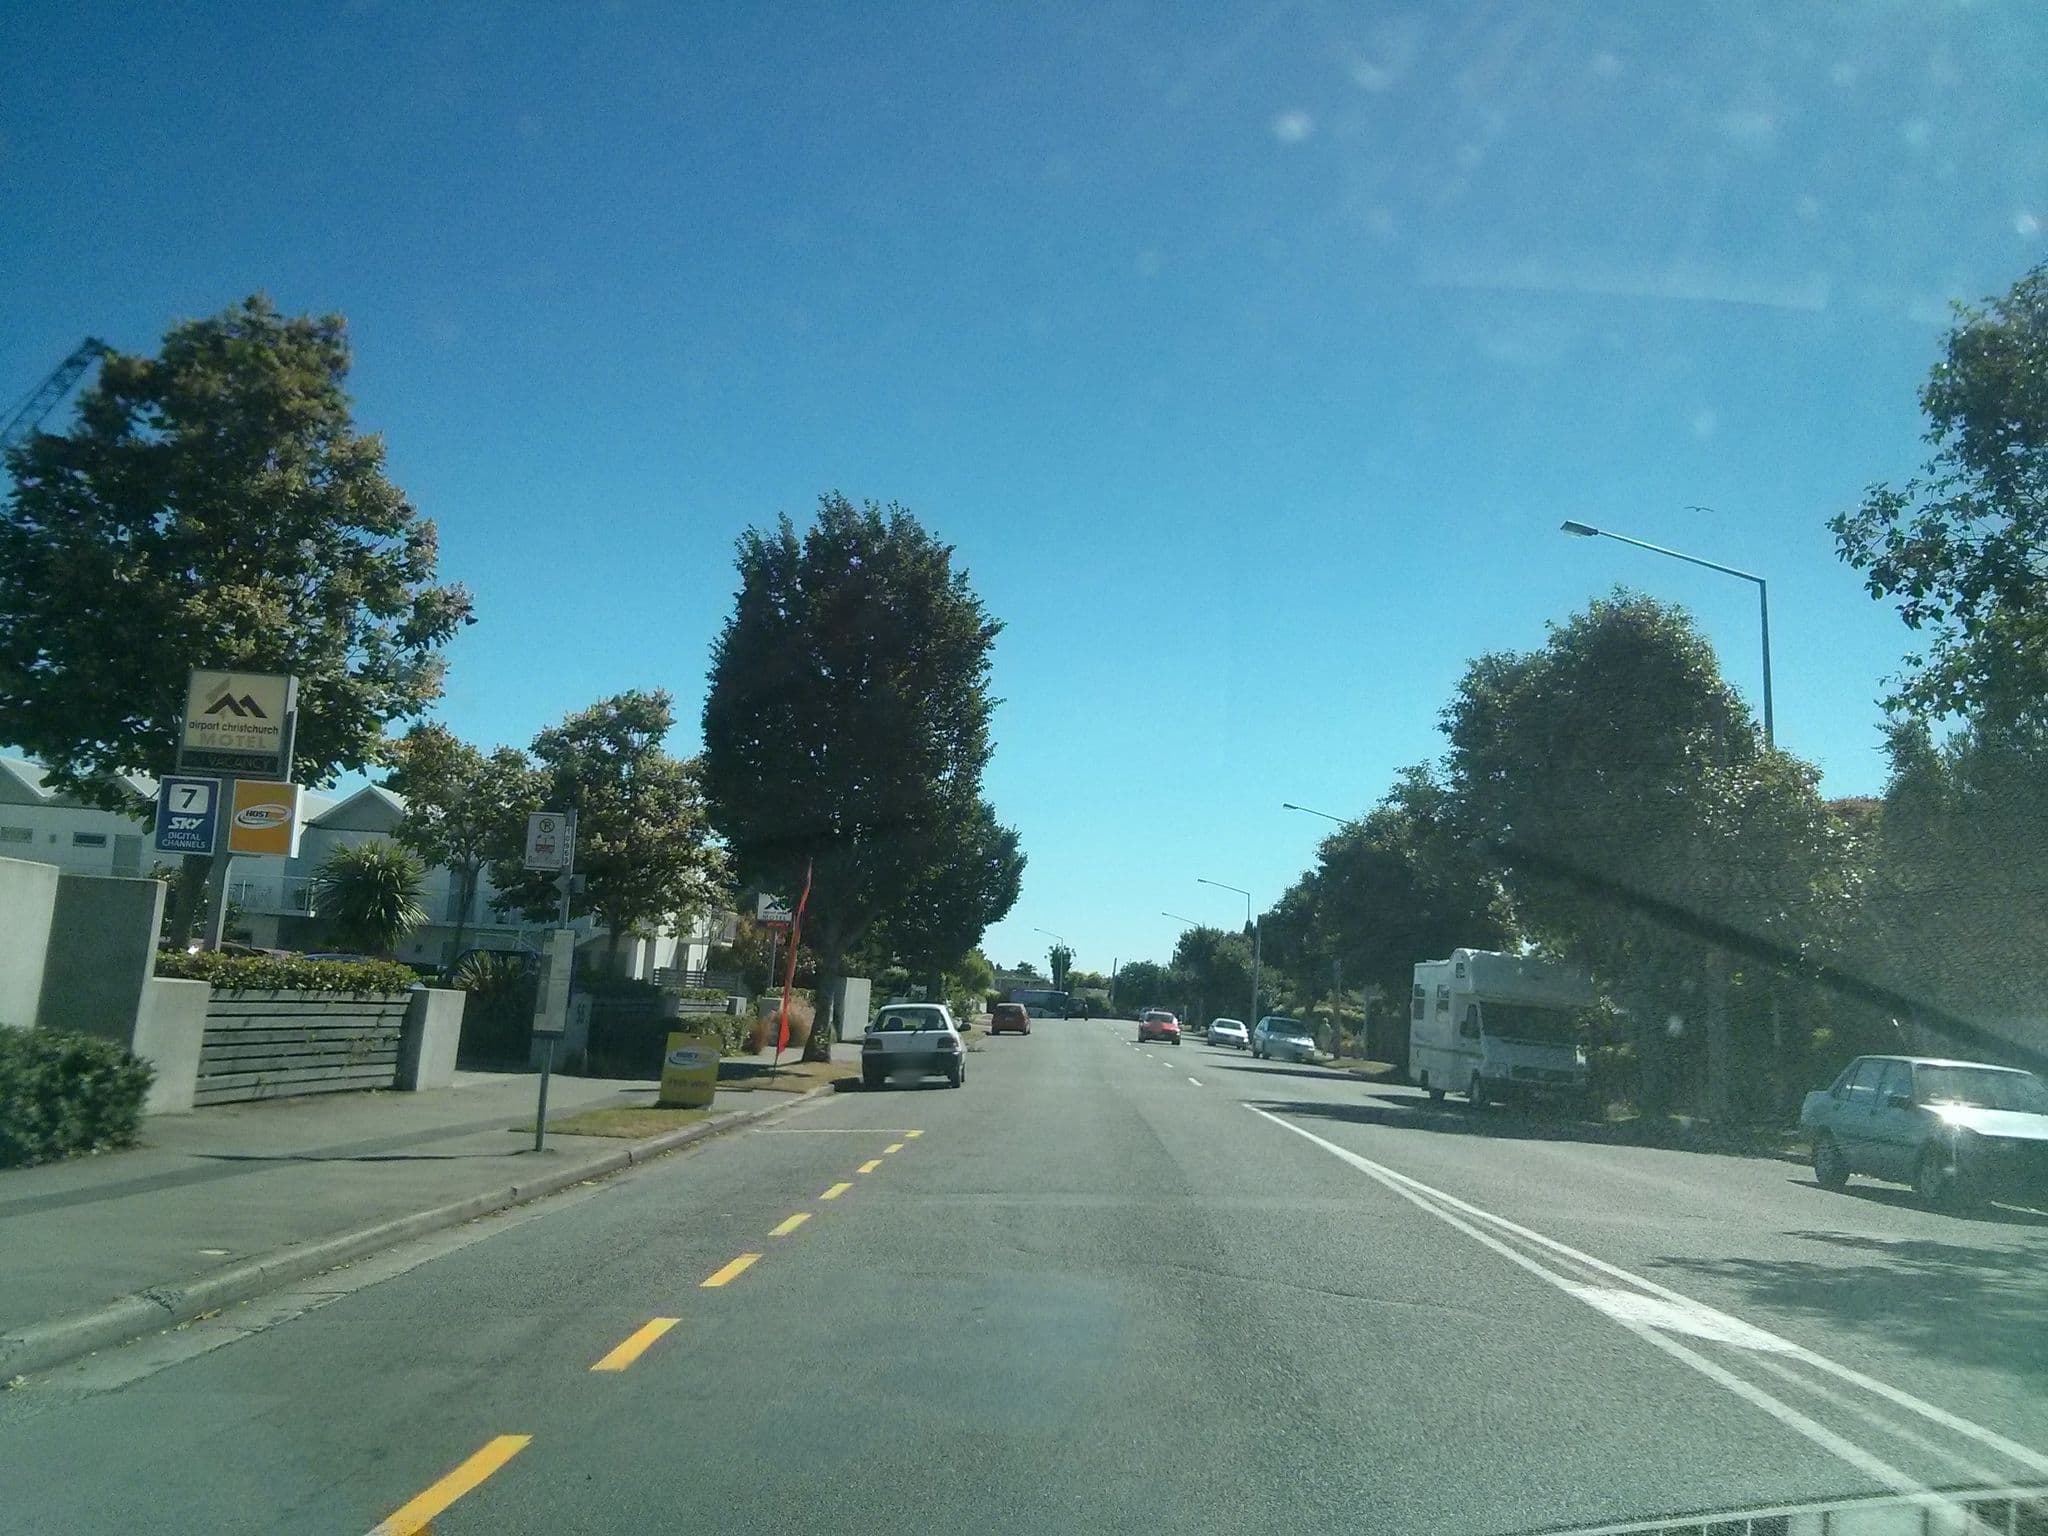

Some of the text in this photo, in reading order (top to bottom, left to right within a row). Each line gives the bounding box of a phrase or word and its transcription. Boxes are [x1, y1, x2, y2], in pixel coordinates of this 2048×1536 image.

[189, 721, 279, 736] airport christchurch
[201, 733, 266, 748] MOTEL
[181, 788, 198, 809] 7
[245, 810, 270, 818] HOST
[168, 817, 205, 830] SKY
[168, 832, 201, 841] DIGITAL
[162, 839, 206, 849] CHANNELS
